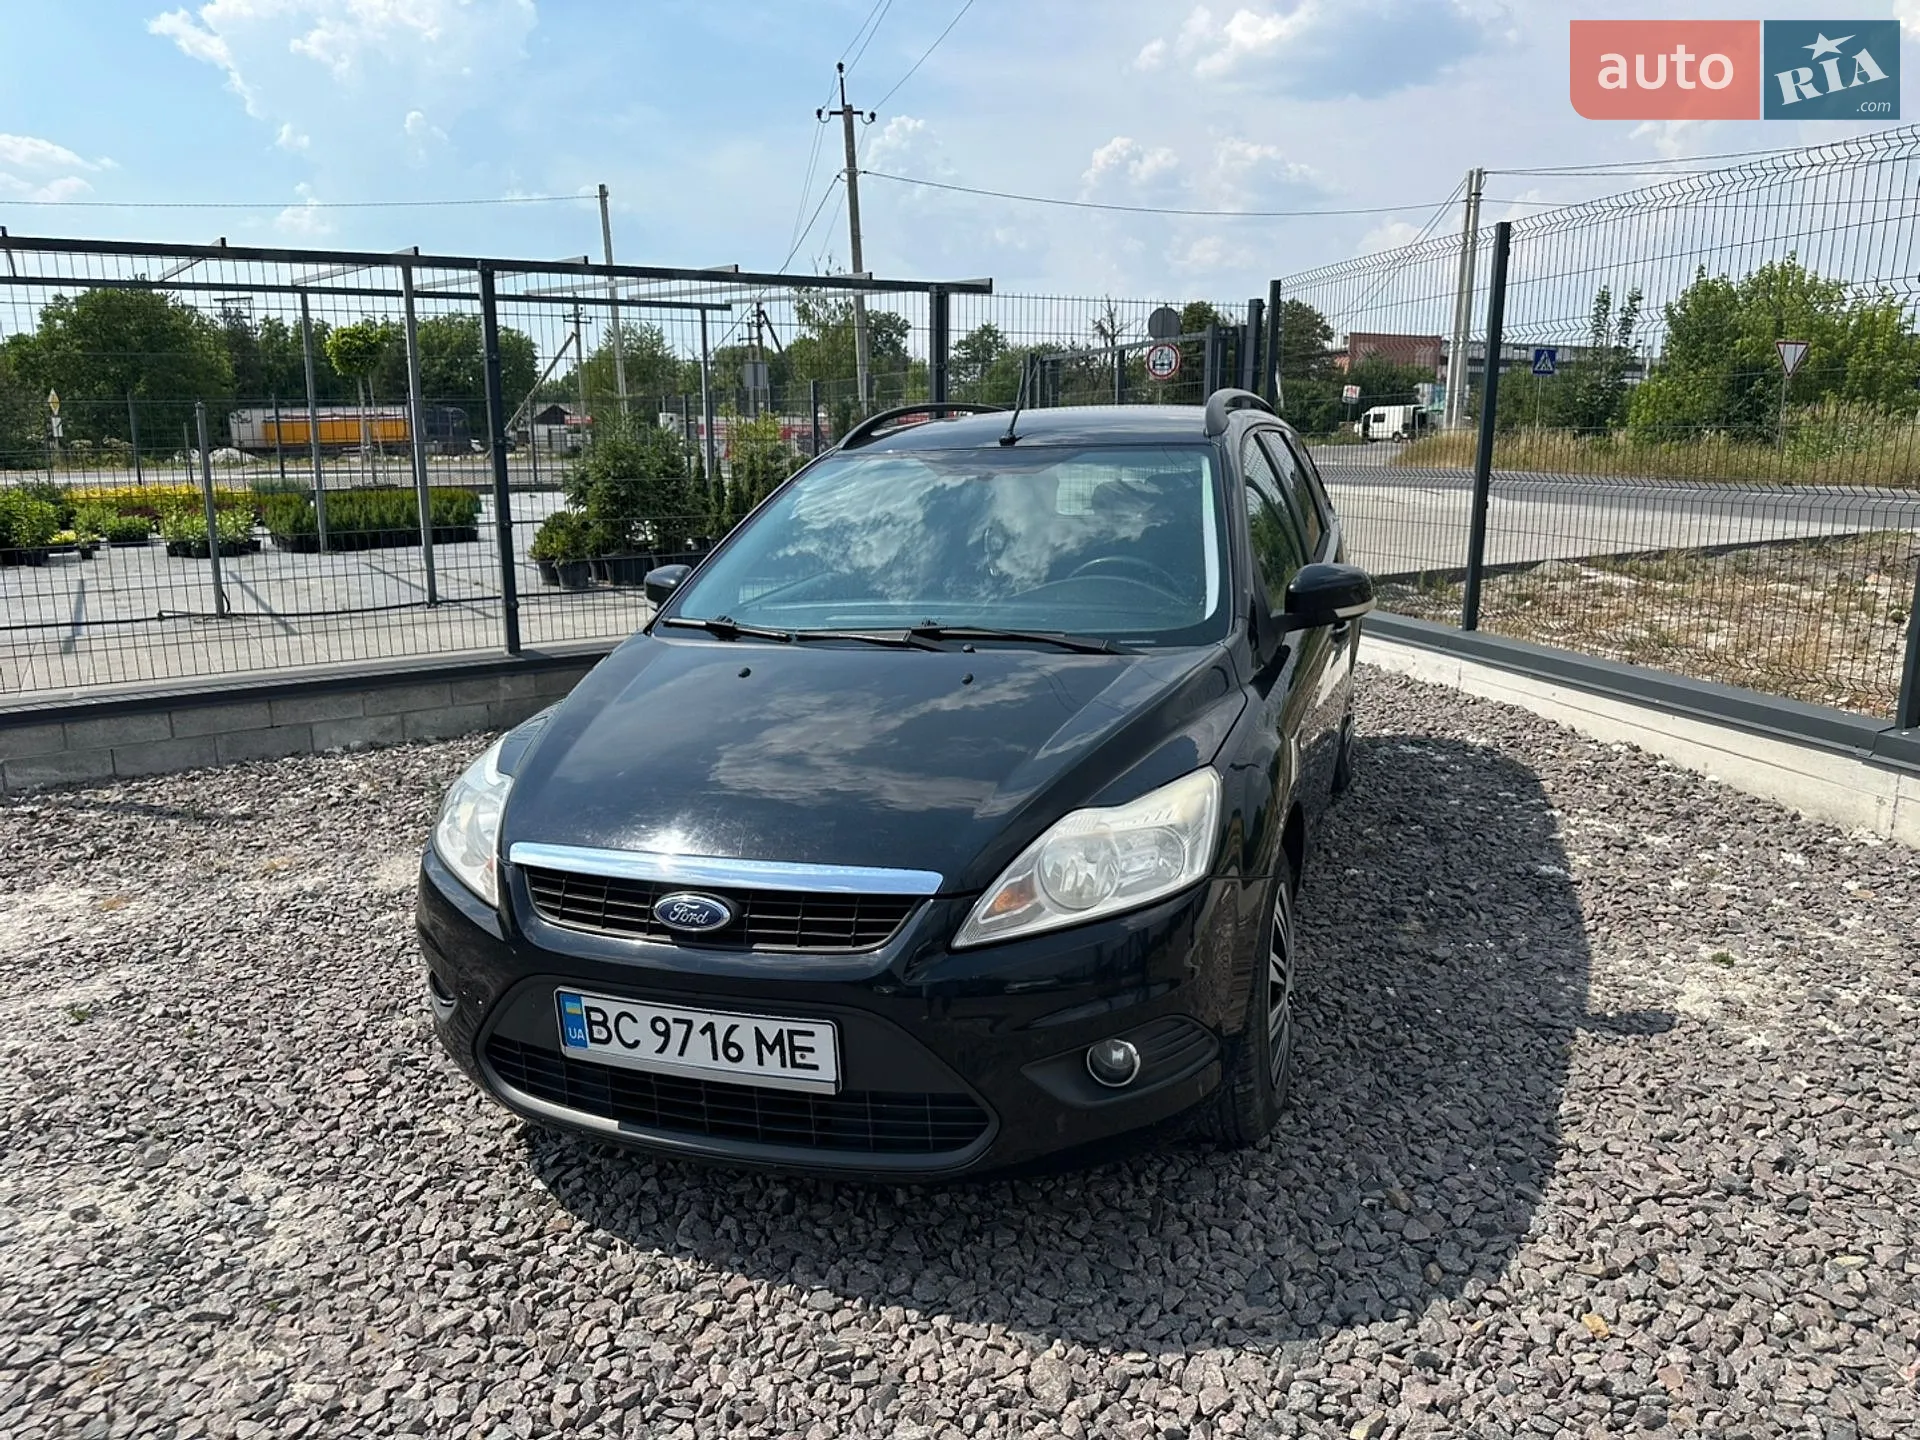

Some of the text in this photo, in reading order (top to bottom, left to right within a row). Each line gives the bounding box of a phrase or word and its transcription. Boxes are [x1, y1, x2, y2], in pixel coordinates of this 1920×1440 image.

[669, 902, 710, 924] Ford
[568, 1027, 585, 1041] UA
[584, 1005, 819, 1071] BC 9716 ME
